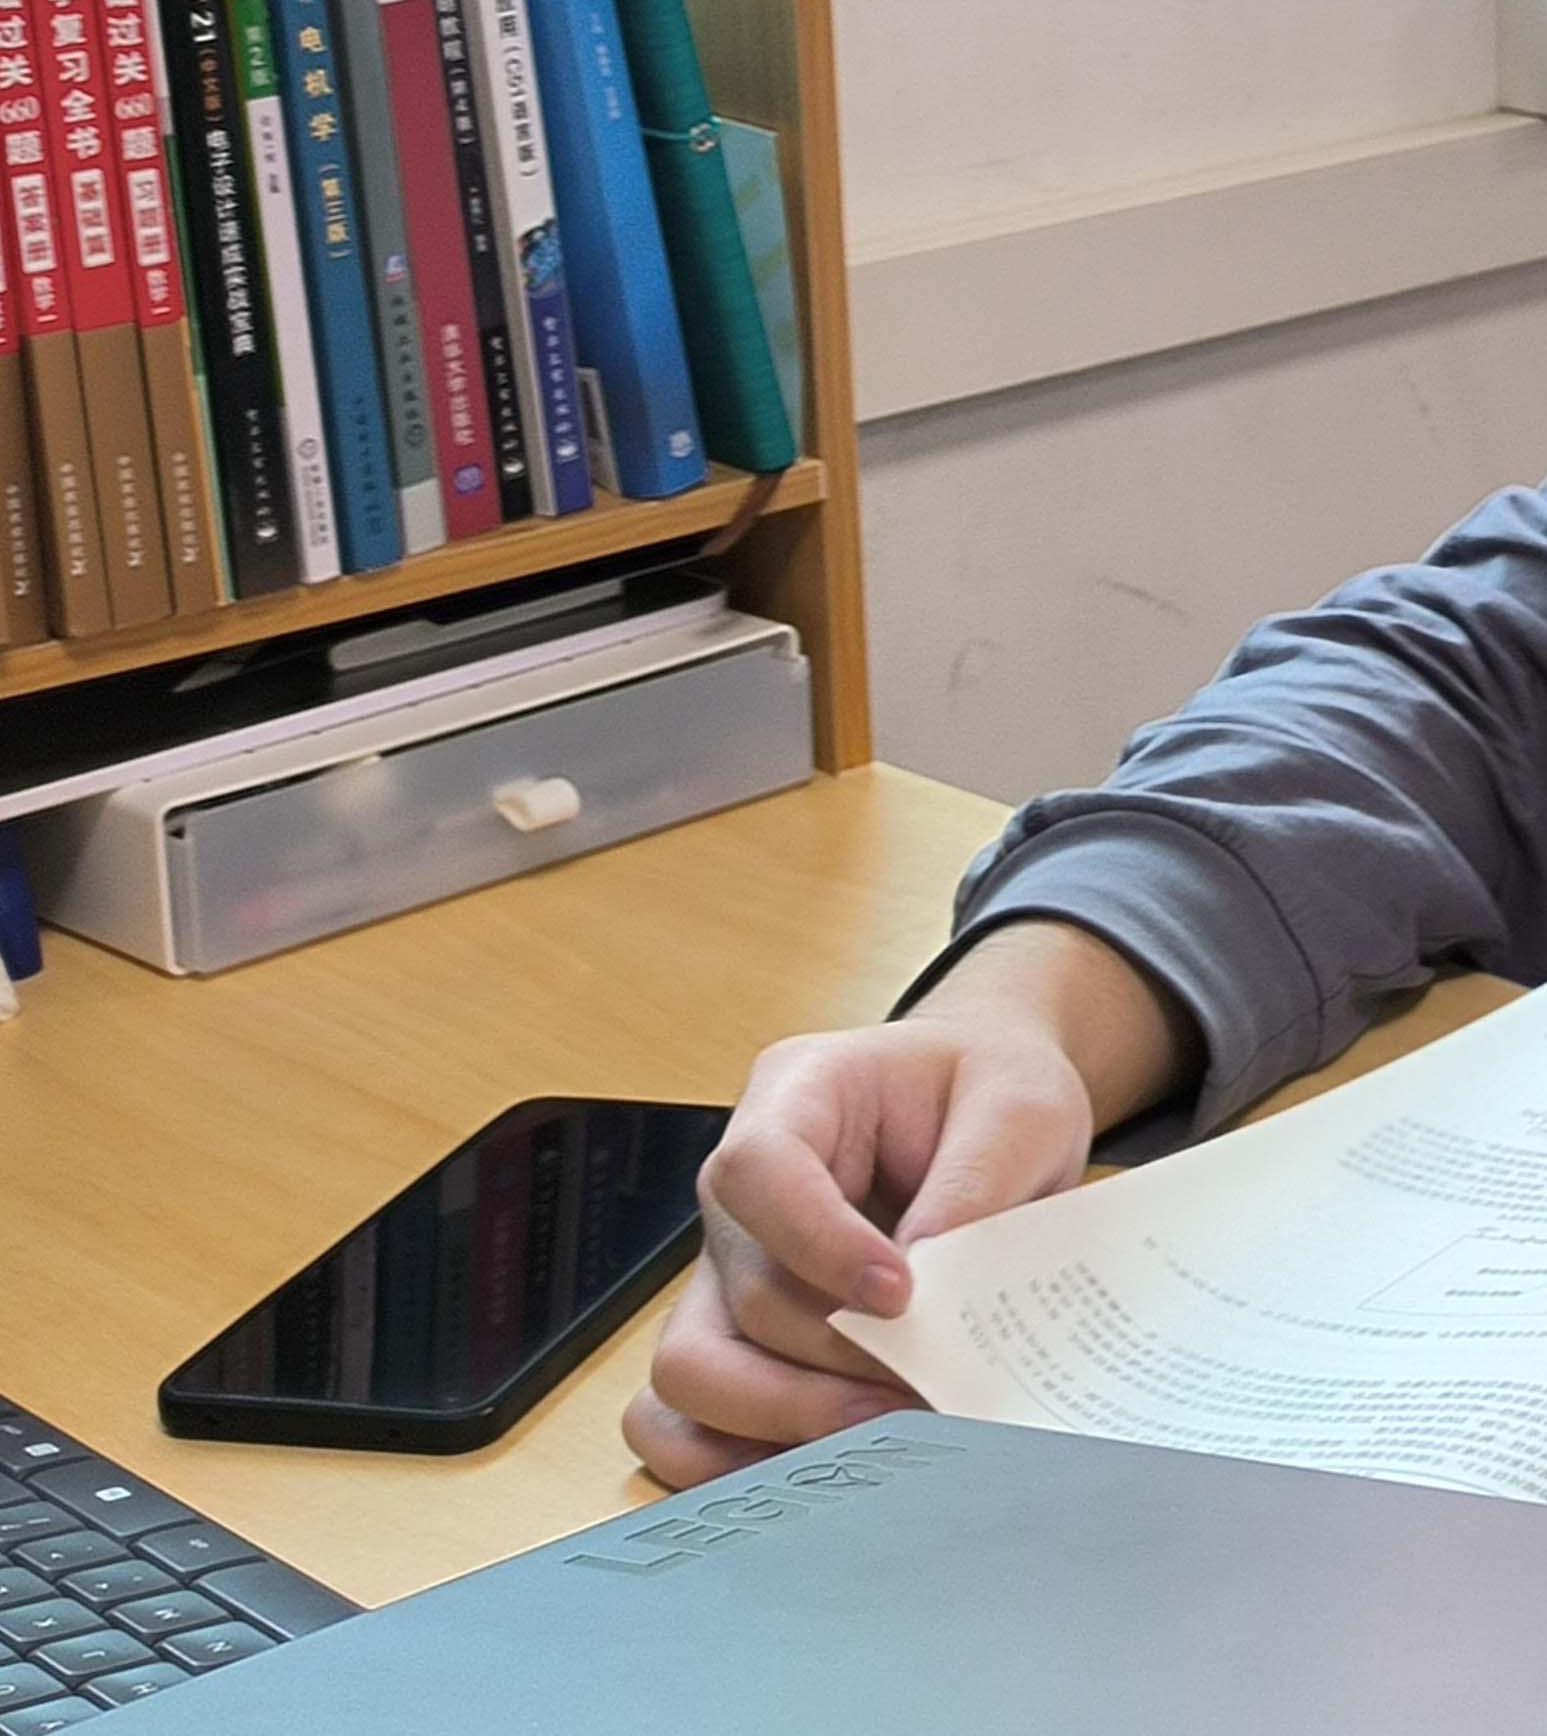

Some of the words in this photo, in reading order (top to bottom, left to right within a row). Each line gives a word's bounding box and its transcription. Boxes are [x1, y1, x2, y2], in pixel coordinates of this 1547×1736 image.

[191, 9, 219, 44] 21
[299, 26, 341, 143] 电机学
[562, 1435, 968, 1576] LEGION
